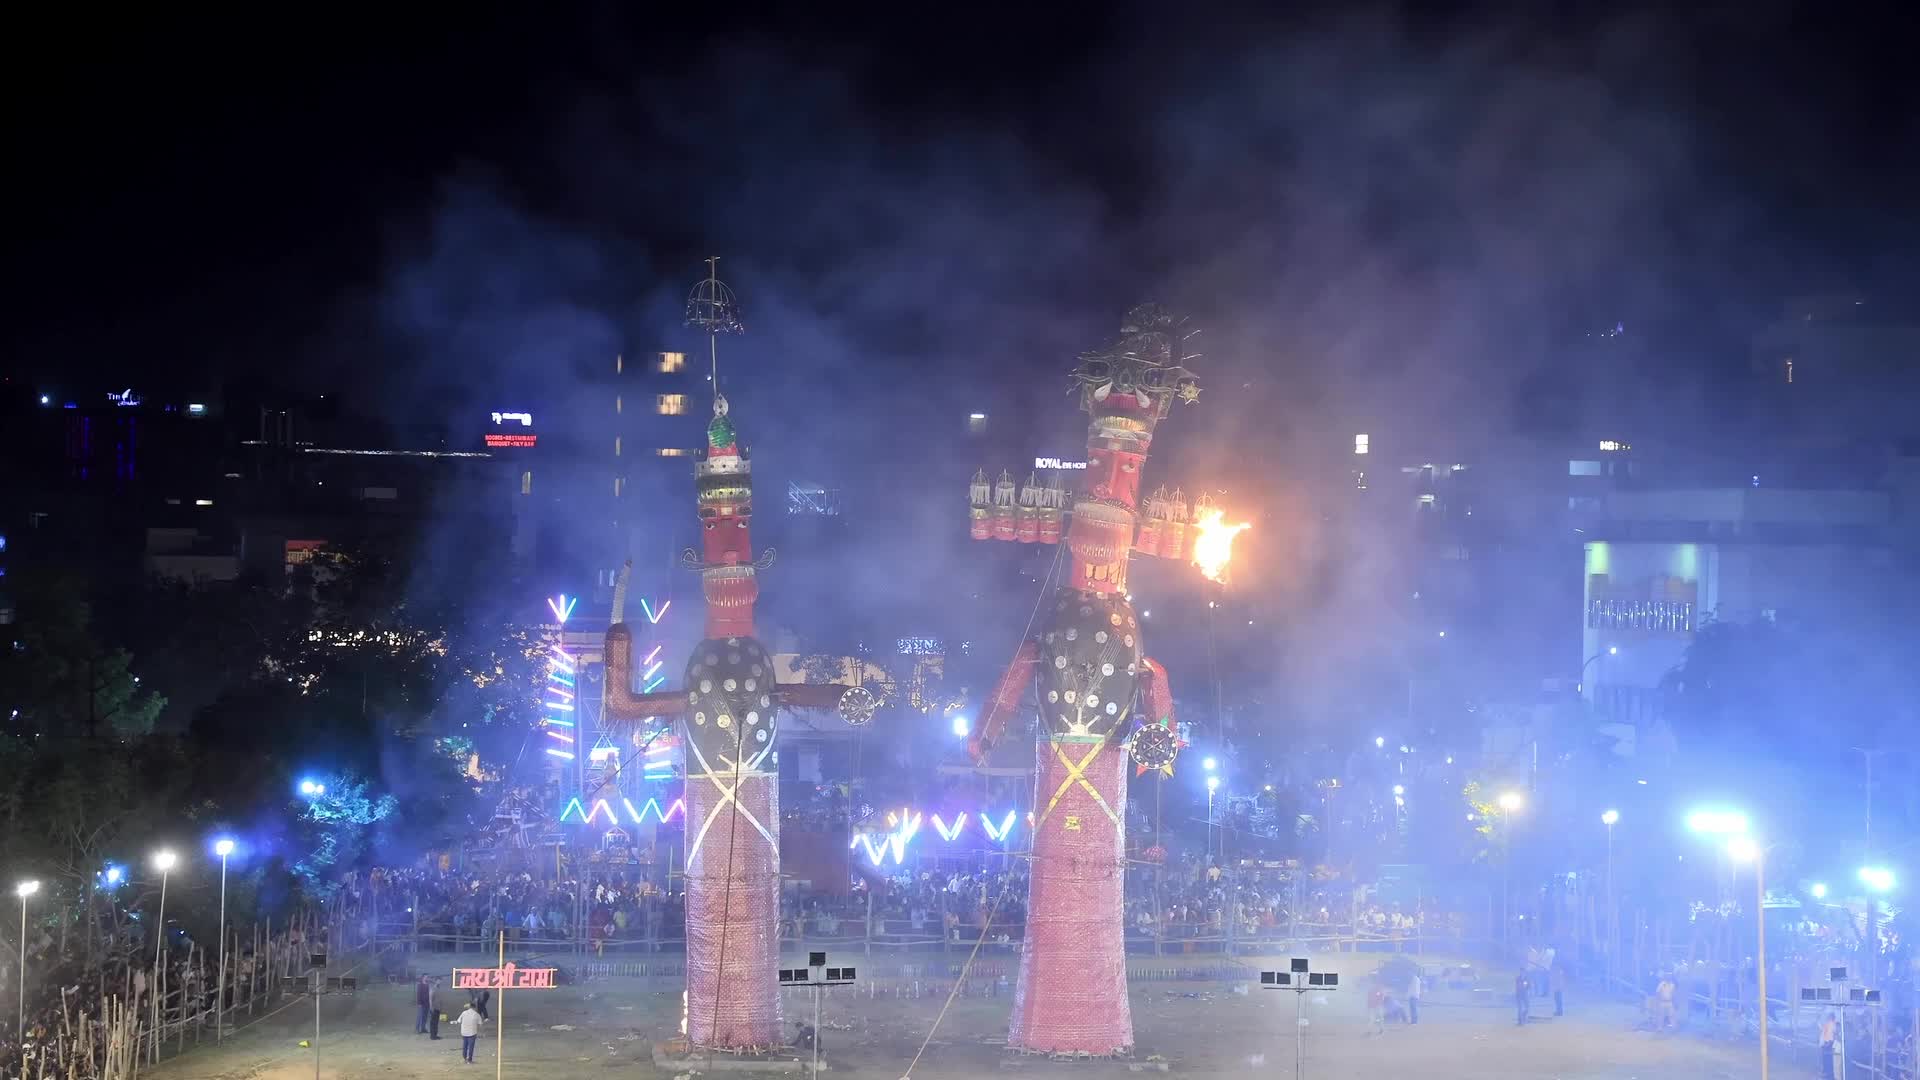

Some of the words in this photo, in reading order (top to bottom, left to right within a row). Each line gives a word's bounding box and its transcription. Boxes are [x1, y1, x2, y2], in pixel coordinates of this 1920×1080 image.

[1035, 457, 1061, 470] ROYAL
[492, 961, 515, 988] श्री
[519, 968, 549, 988] राम
